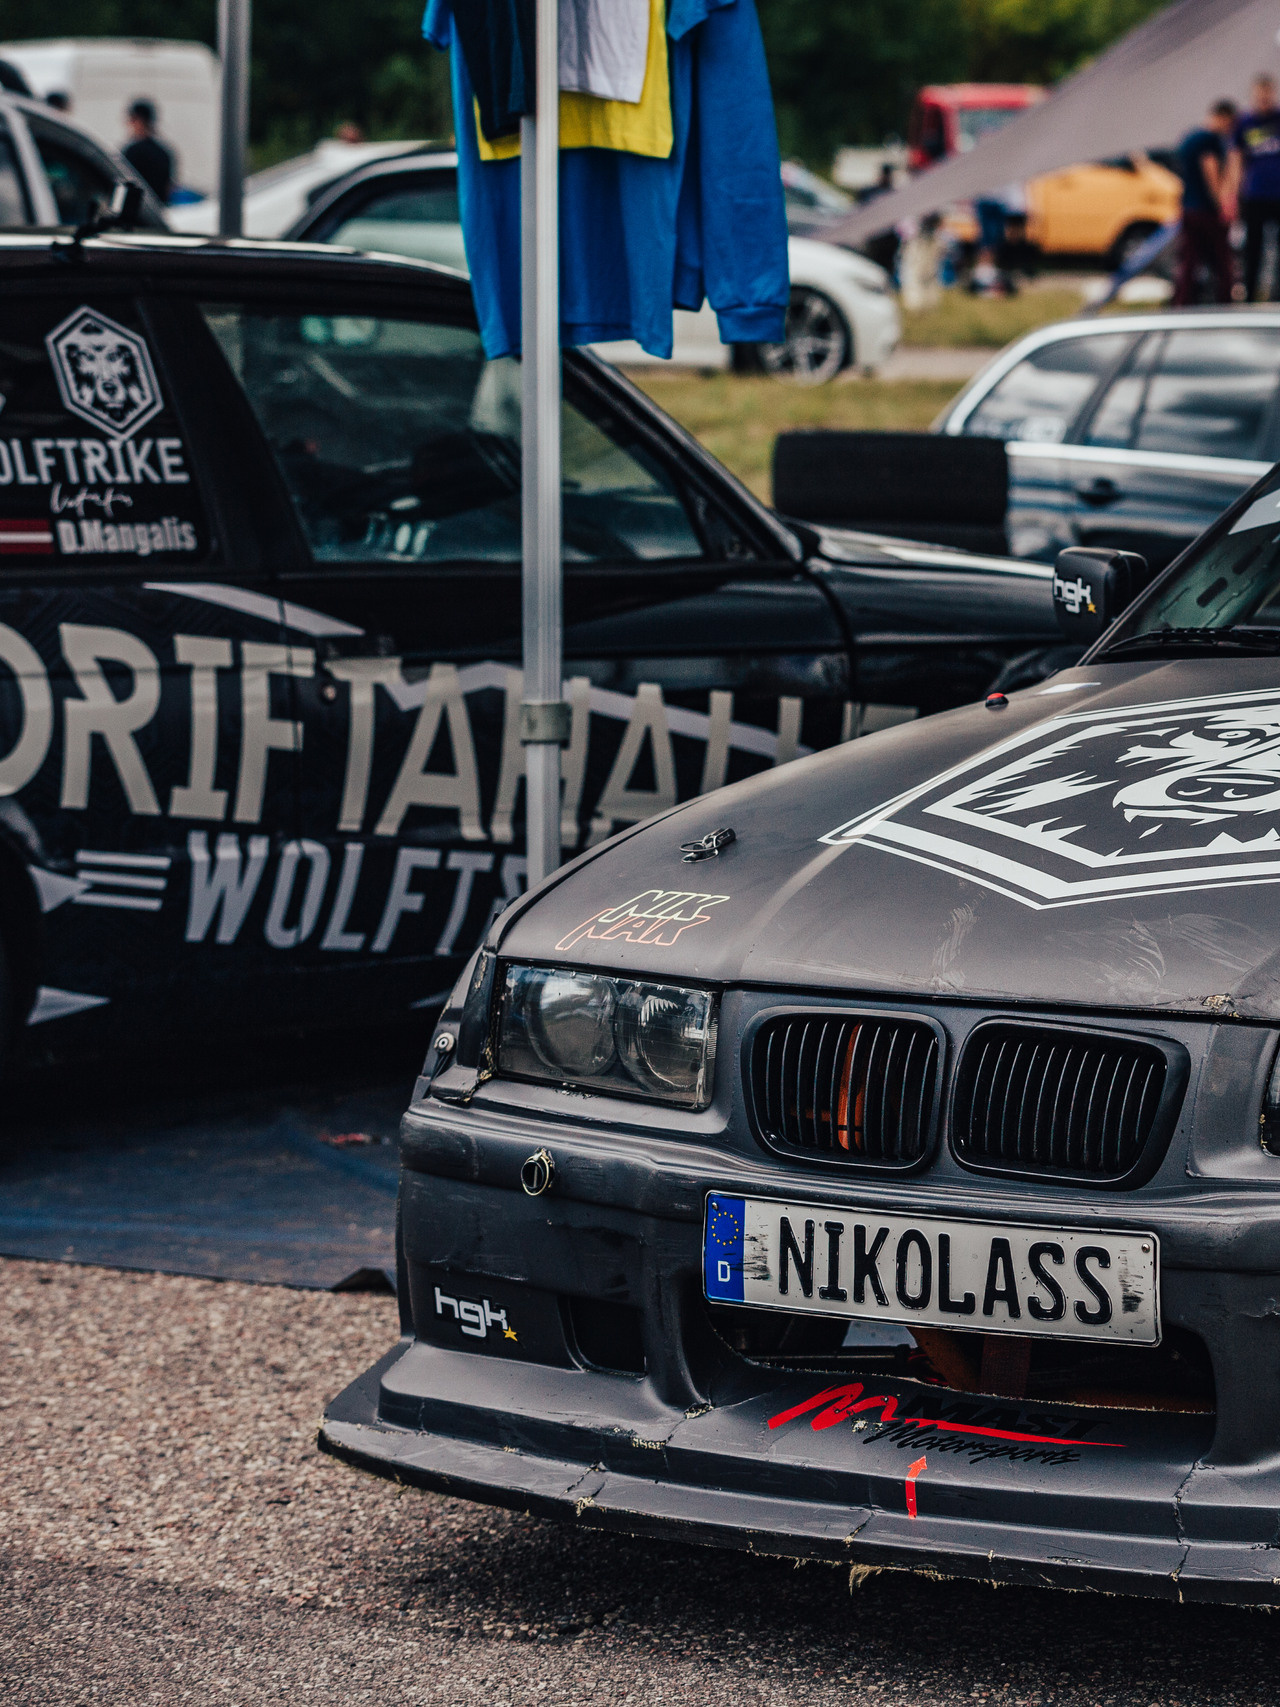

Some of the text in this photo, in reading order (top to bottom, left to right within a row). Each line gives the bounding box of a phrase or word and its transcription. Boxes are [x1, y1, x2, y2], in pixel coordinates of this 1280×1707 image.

[1053, 573, 1092, 613] hgk
[717, 1260, 731, 1283] D
[778, 1215, 1113, 1325] NIKOLASS
[434, 1286, 508, 1338] hgk
